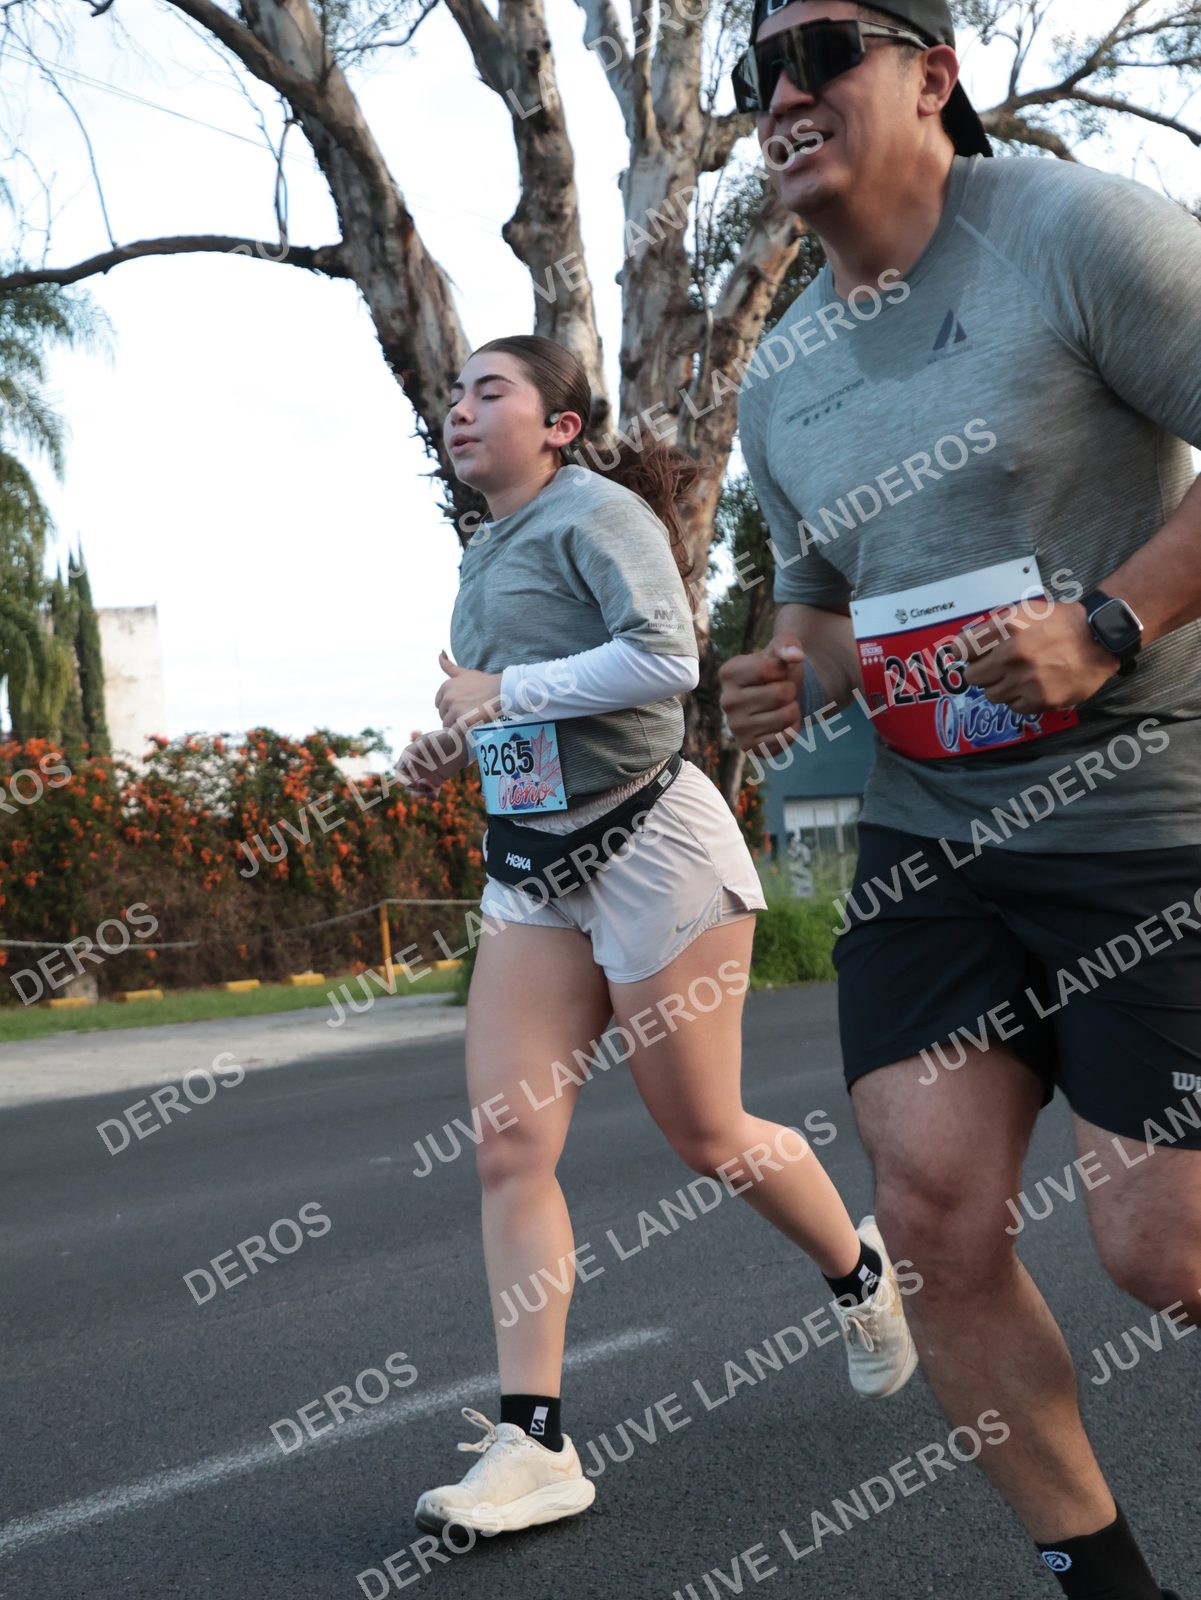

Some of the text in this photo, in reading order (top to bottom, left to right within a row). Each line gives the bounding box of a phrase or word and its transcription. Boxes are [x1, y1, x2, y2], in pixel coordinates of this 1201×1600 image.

[909, 601, 956, 619] Cinemex
[883, 643, 973, 707] 216
[480, 740, 534, 776] 3265
[505, 852, 532, 871] HOKA
